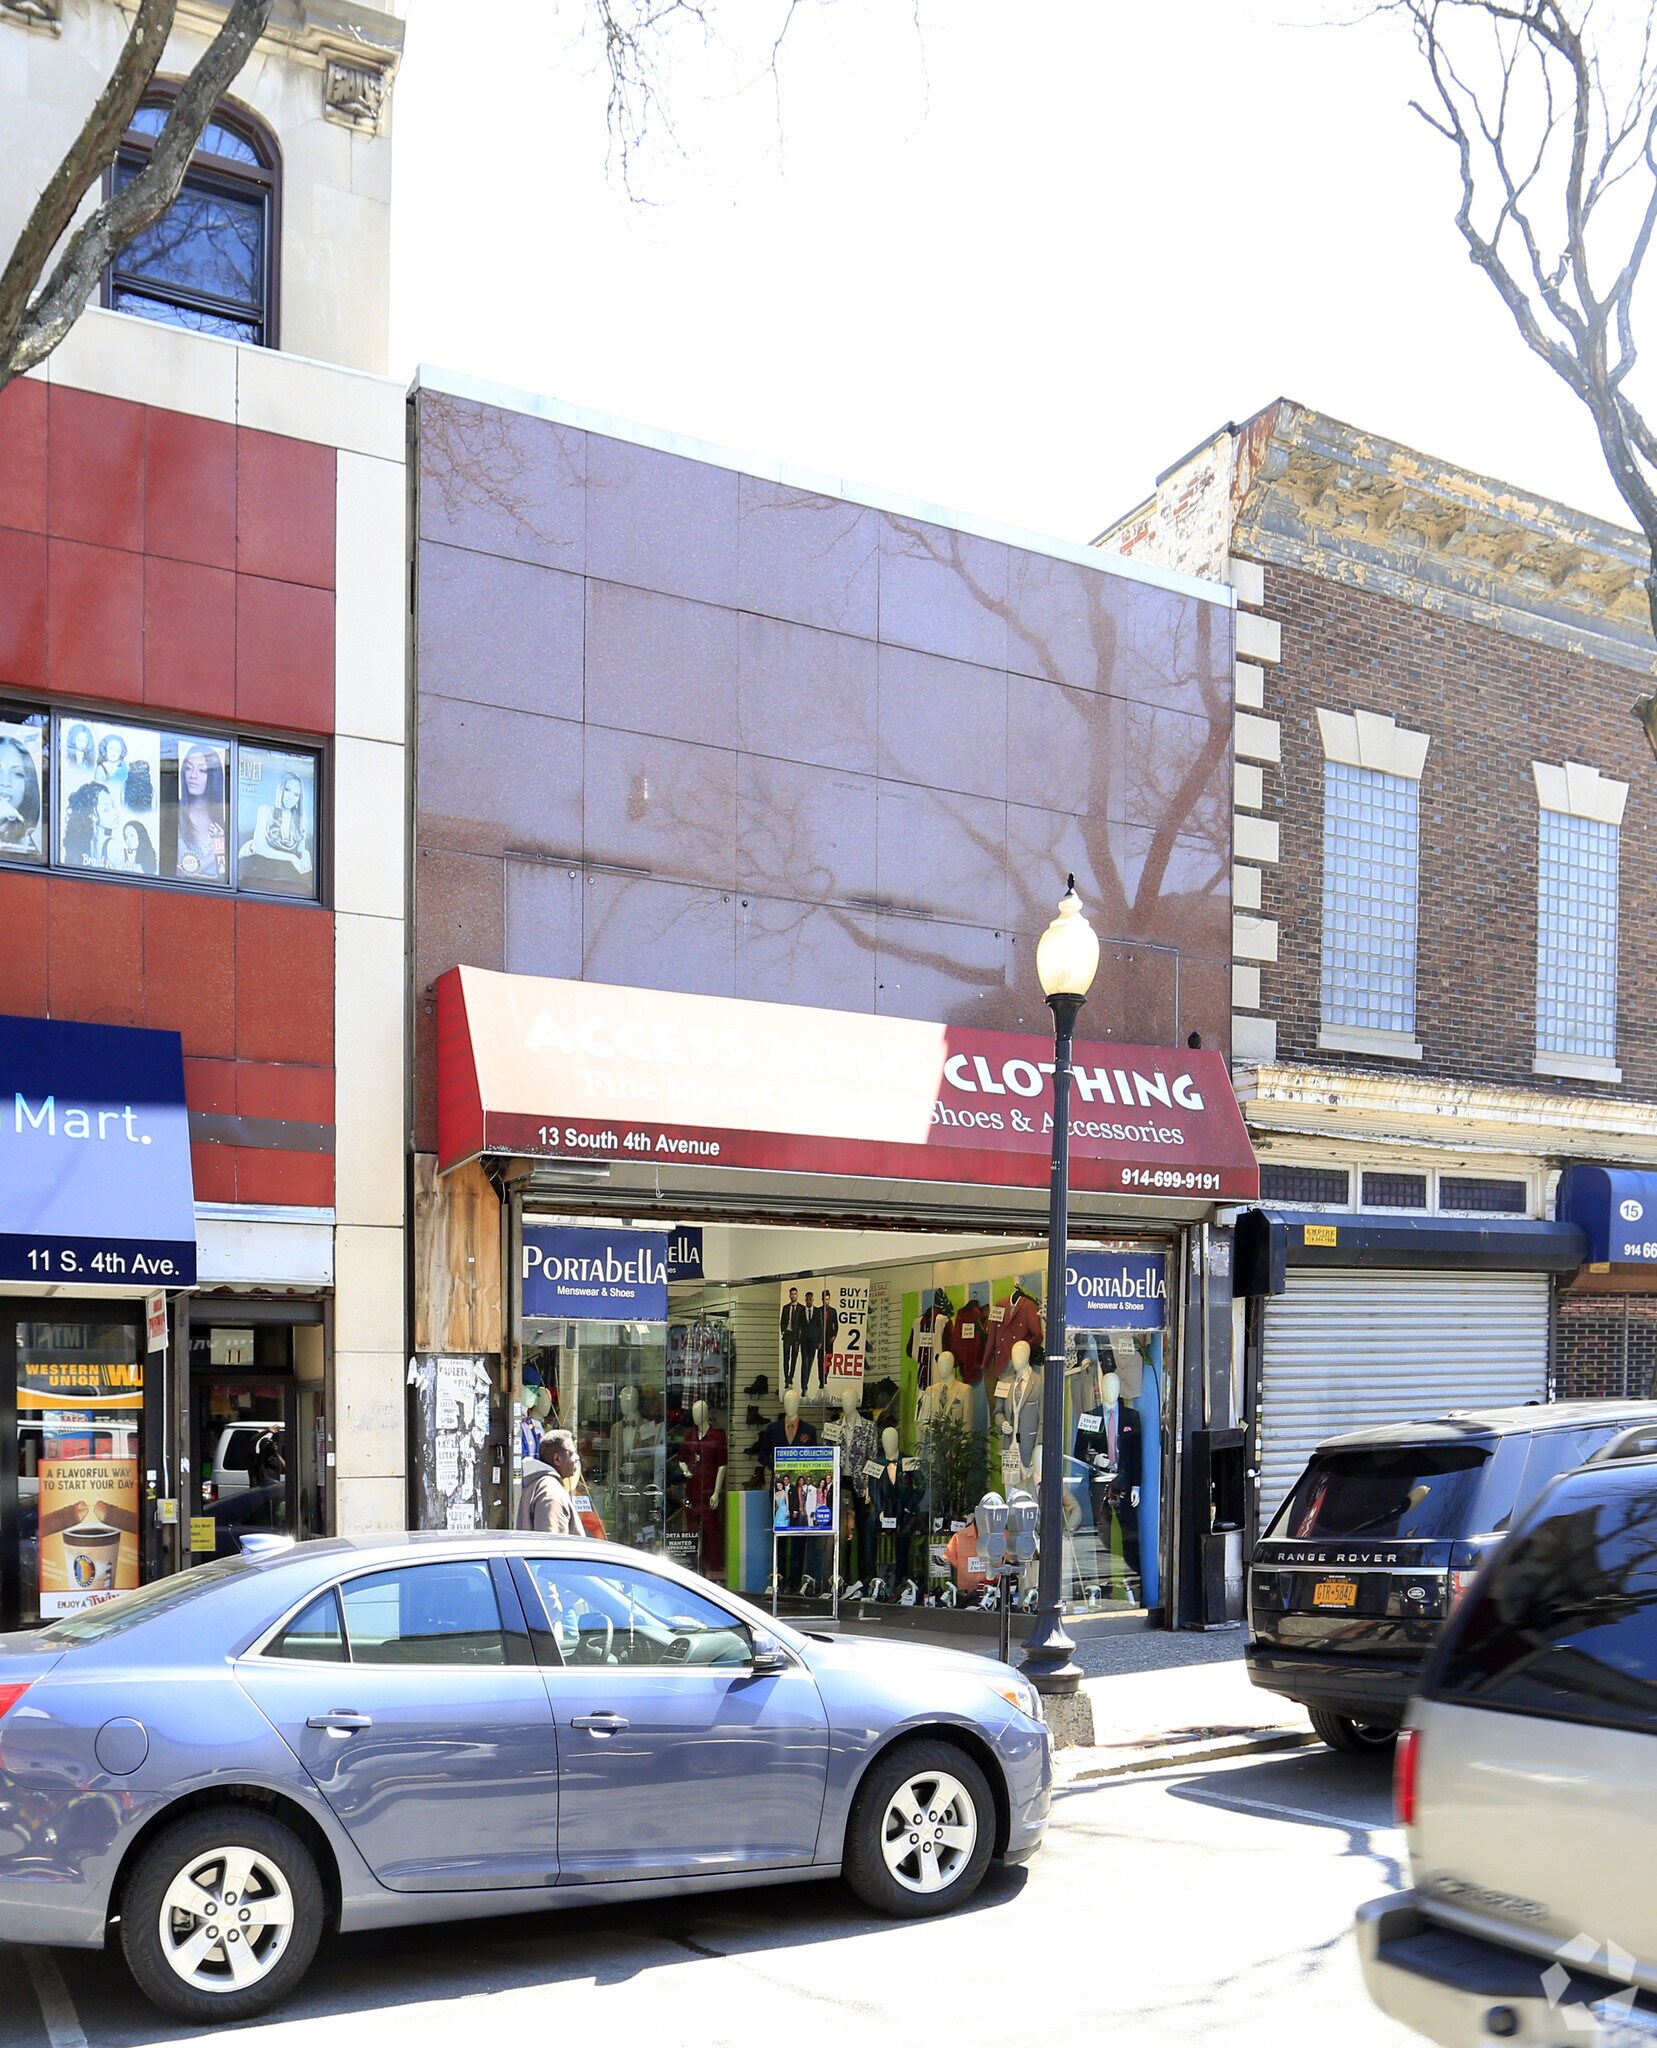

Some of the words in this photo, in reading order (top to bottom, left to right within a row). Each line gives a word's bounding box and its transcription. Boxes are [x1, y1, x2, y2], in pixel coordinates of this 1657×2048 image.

[15, 1092, 152, 1145] Mart.
[1011, 1109, 1035, 1134] &
[538, 1126, 560, 1146] 13
[565, 1128, 618, 1149] South
[623, 1132, 651, 1151] 4th
[655, 1134, 720, 1156] Avenue
[1121, 1168, 1220, 1190] 914-699-9191
[1623, 1205, 1639, 1218] 15
[1624, 1243, 1641, 1256] 914
[27, 1249, 50, 1271] 11
[60, 1250, 84, 1272] S.
[90, 1251, 126, 1274] 4th
[131, 1253, 180, 1276] Ave.
[557, 1285, 600, 1297] Menswear
[601, 1287, 608, 1297] &
[610, 1287, 636, 1298] Shoes
[840, 1287, 861, 1298] BUY
[863, 1288, 868, 1298] 1
[840, 1299, 867, 1309] SUIT
[1087, 1301, 1118, 1310] Menswear
[1119, 1301, 1124, 1310] &
[1125, 1301, 1144, 1311] Shoes
[839, 1312, 866, 1324] GET
[847, 1329, 861, 1351] 2
[25, 1364, 99, 1375] WESTERN
[824, 1353, 864, 1377] FREE
[49, 1375, 100, 1387] UNION
[46, 1468, 54, 1479] A
[57, 1468, 108, 1479] FLAVORFUL
[112, 1468, 131, 1477] WAY
[44, 1480, 55, 1490] TO
[58, 1480, 86, 1490] START
[90, 1480, 115, 1490] YOUR
[118, 1479, 134, 1490] DAY
[1278, 1552, 1326, 1562] RANGE
[1336, 1553, 1397, 1563] ROVER
[57, 1600, 80, 1609] ENJOY
[81, 1600, 87, 1608] A
